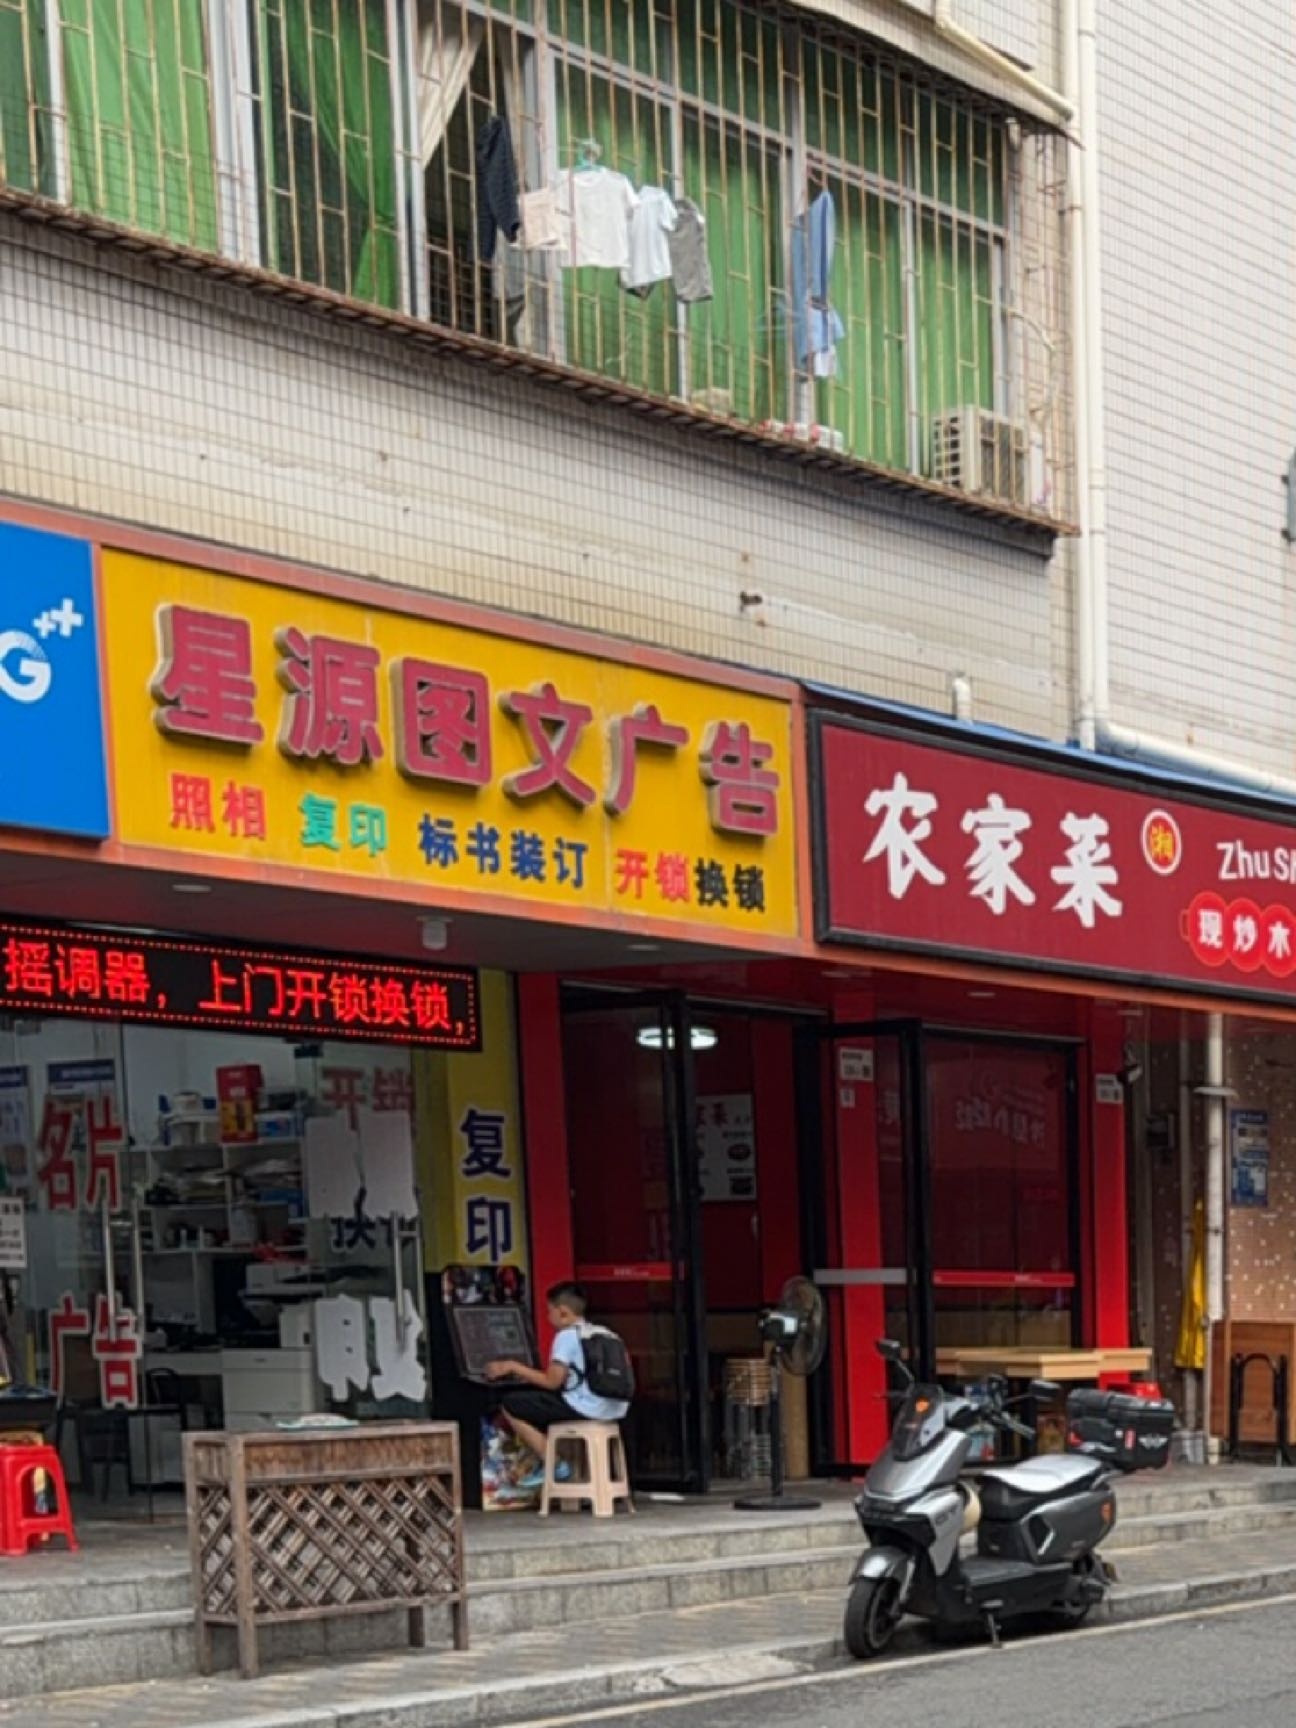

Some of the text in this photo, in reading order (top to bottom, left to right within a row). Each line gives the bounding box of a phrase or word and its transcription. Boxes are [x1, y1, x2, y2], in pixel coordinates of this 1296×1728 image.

[151, 604, 779, 836] 星源图文广告
[170, 773, 766, 913] 照相 复印 标书装订 开锁换锁
[863, 772, 1123, 928] 农家菜
[38, 1094, 123, 1211] 名片
[459, 1108, 512, 1262] 复印
[50, 1293, 141, 1407] 广告
